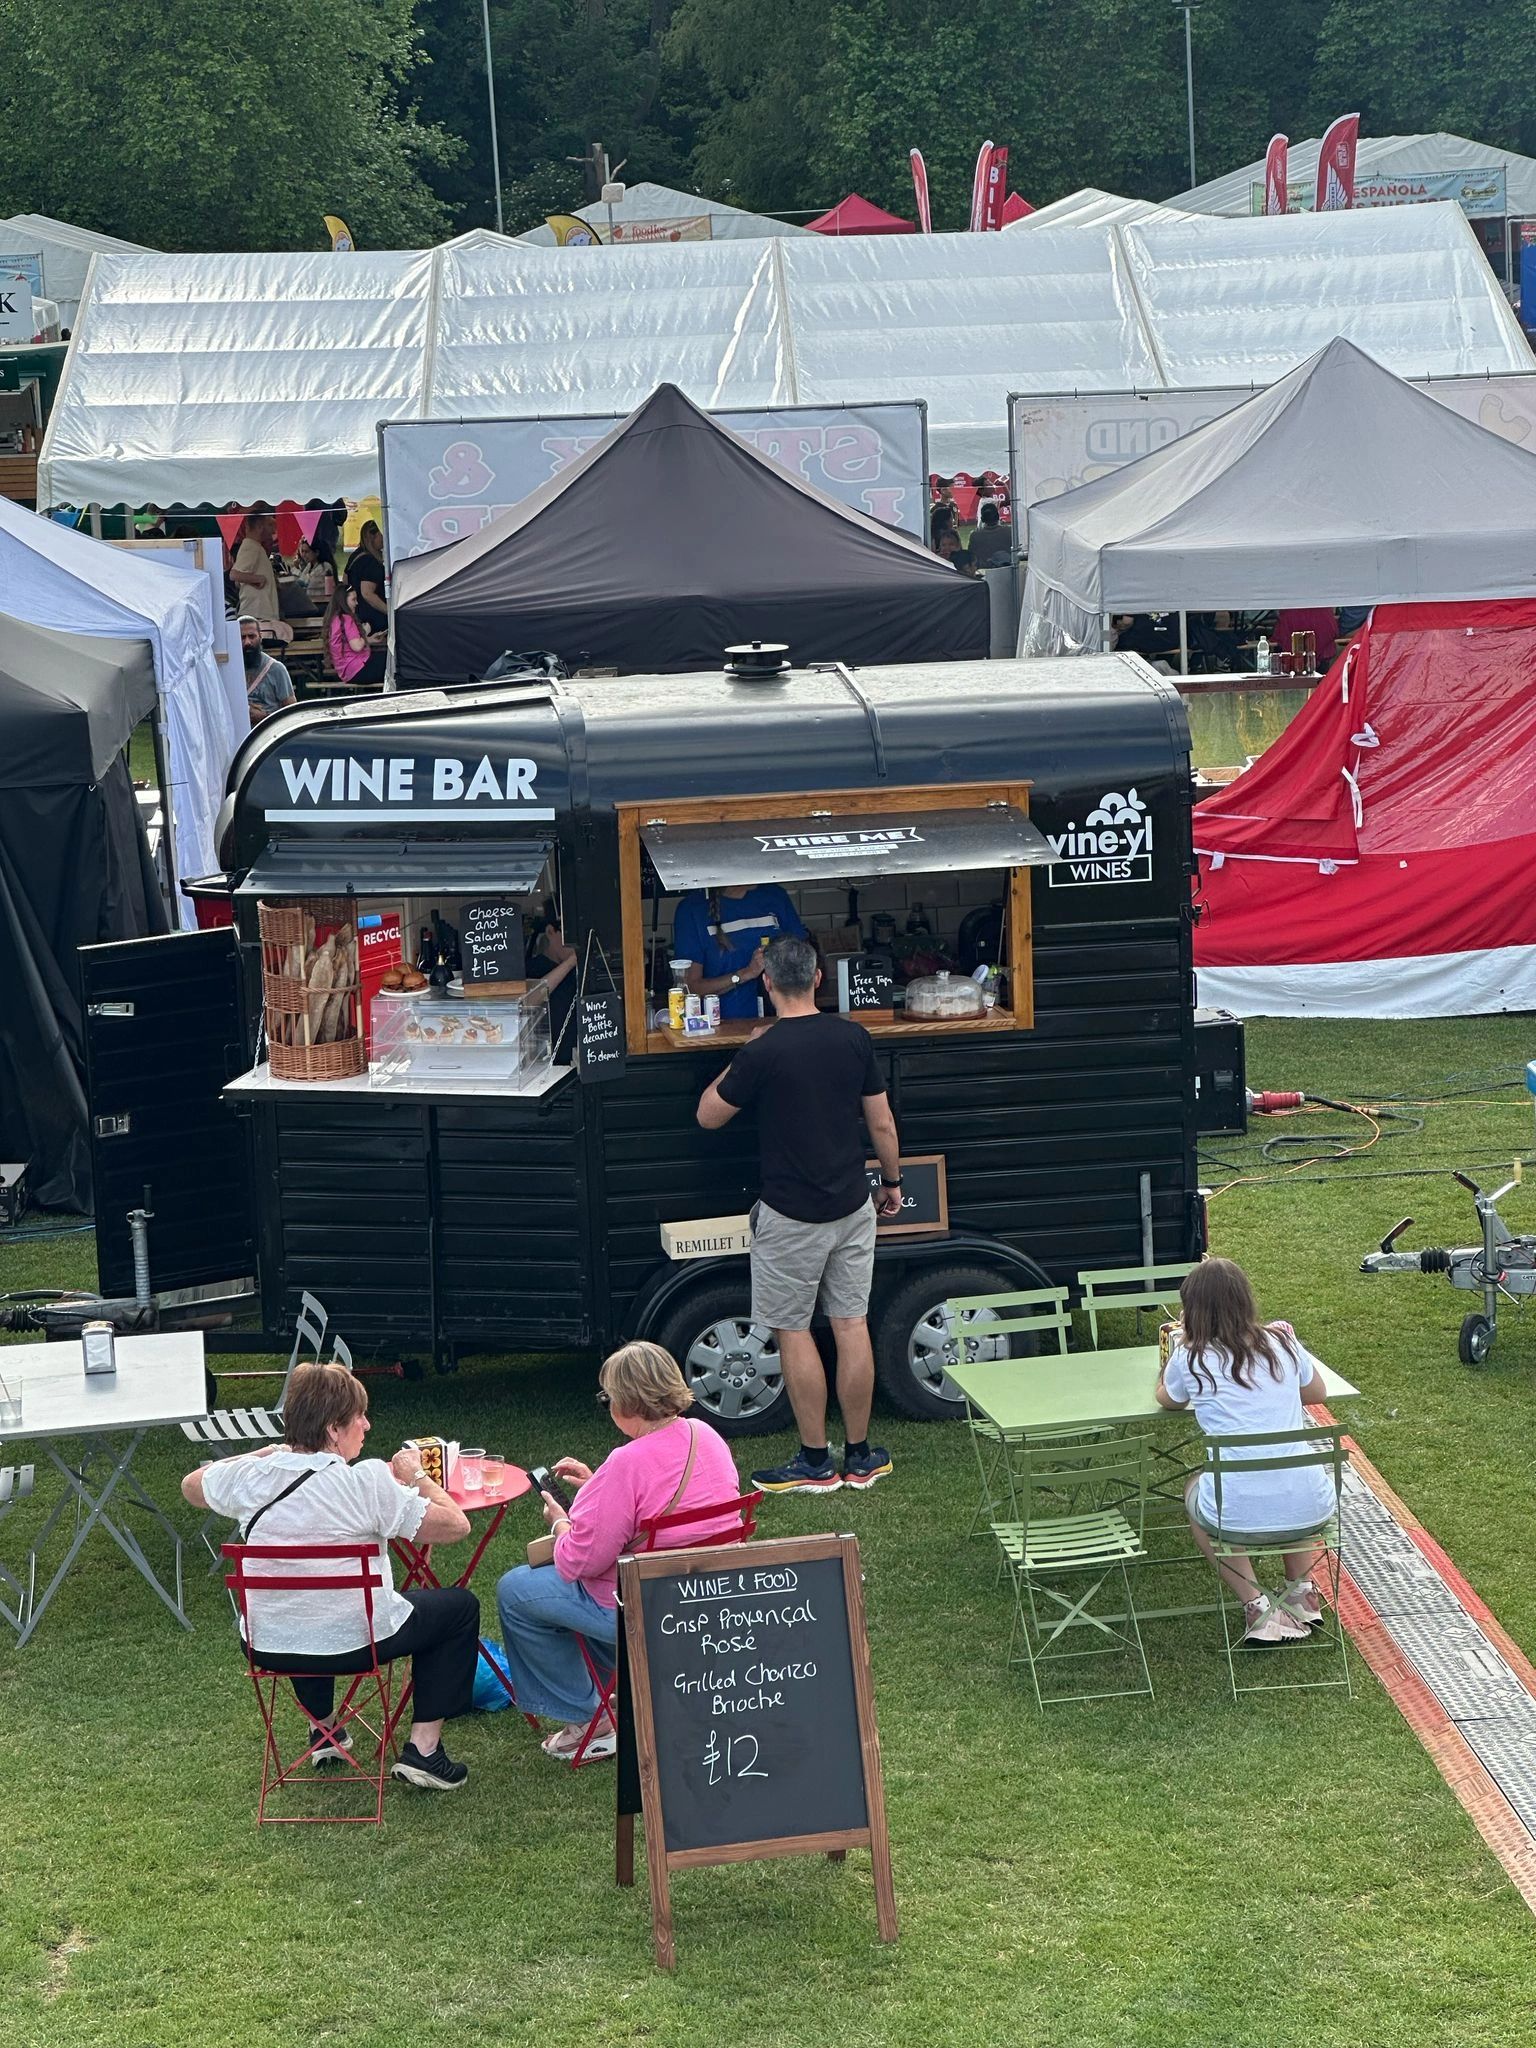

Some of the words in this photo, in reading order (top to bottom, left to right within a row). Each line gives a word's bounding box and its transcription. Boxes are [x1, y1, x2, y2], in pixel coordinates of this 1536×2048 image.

[1354, 182, 1428, 199] ESPAÑOLA
[279, 757, 415, 804] WINE
[432, 754, 538, 802] BAR
[773, 835, 850, 848] HIRE
[860, 831, 906, 843] ME
[1070, 861, 1132, 881] WINES
[468, 906, 515, 921] Cheese
[475, 917, 499, 931] and
[464, 925, 508, 945] Salami
[471, 941, 508, 955] Board
[471, 957, 500, 978] £15
[852, 974, 873, 987] Free
[849, 986, 867, 996] with
[869, 986, 877, 995] a
[853, 994, 881, 1007] drink
[585, 1000, 608, 1012] Wine
[587, 1019, 613, 1033] Bottle
[594, 1012, 606, 1022] the
[582, 1026, 618, 1045] decanted
[676, 1236, 734, 1255] REMILLET
[677, 1576, 732, 1599] WINE
[753, 1568, 799, 1590] FOOD
[660, 1612, 708, 1635] Crisp
[718, 1599, 817, 1629] Provençal
[701, 1629, 759, 1656] Rosé
[673, 1669, 737, 1695] Grilled
[711, 1687, 786, 1716] Brioche
[701, 1730, 770, 1787] £12
